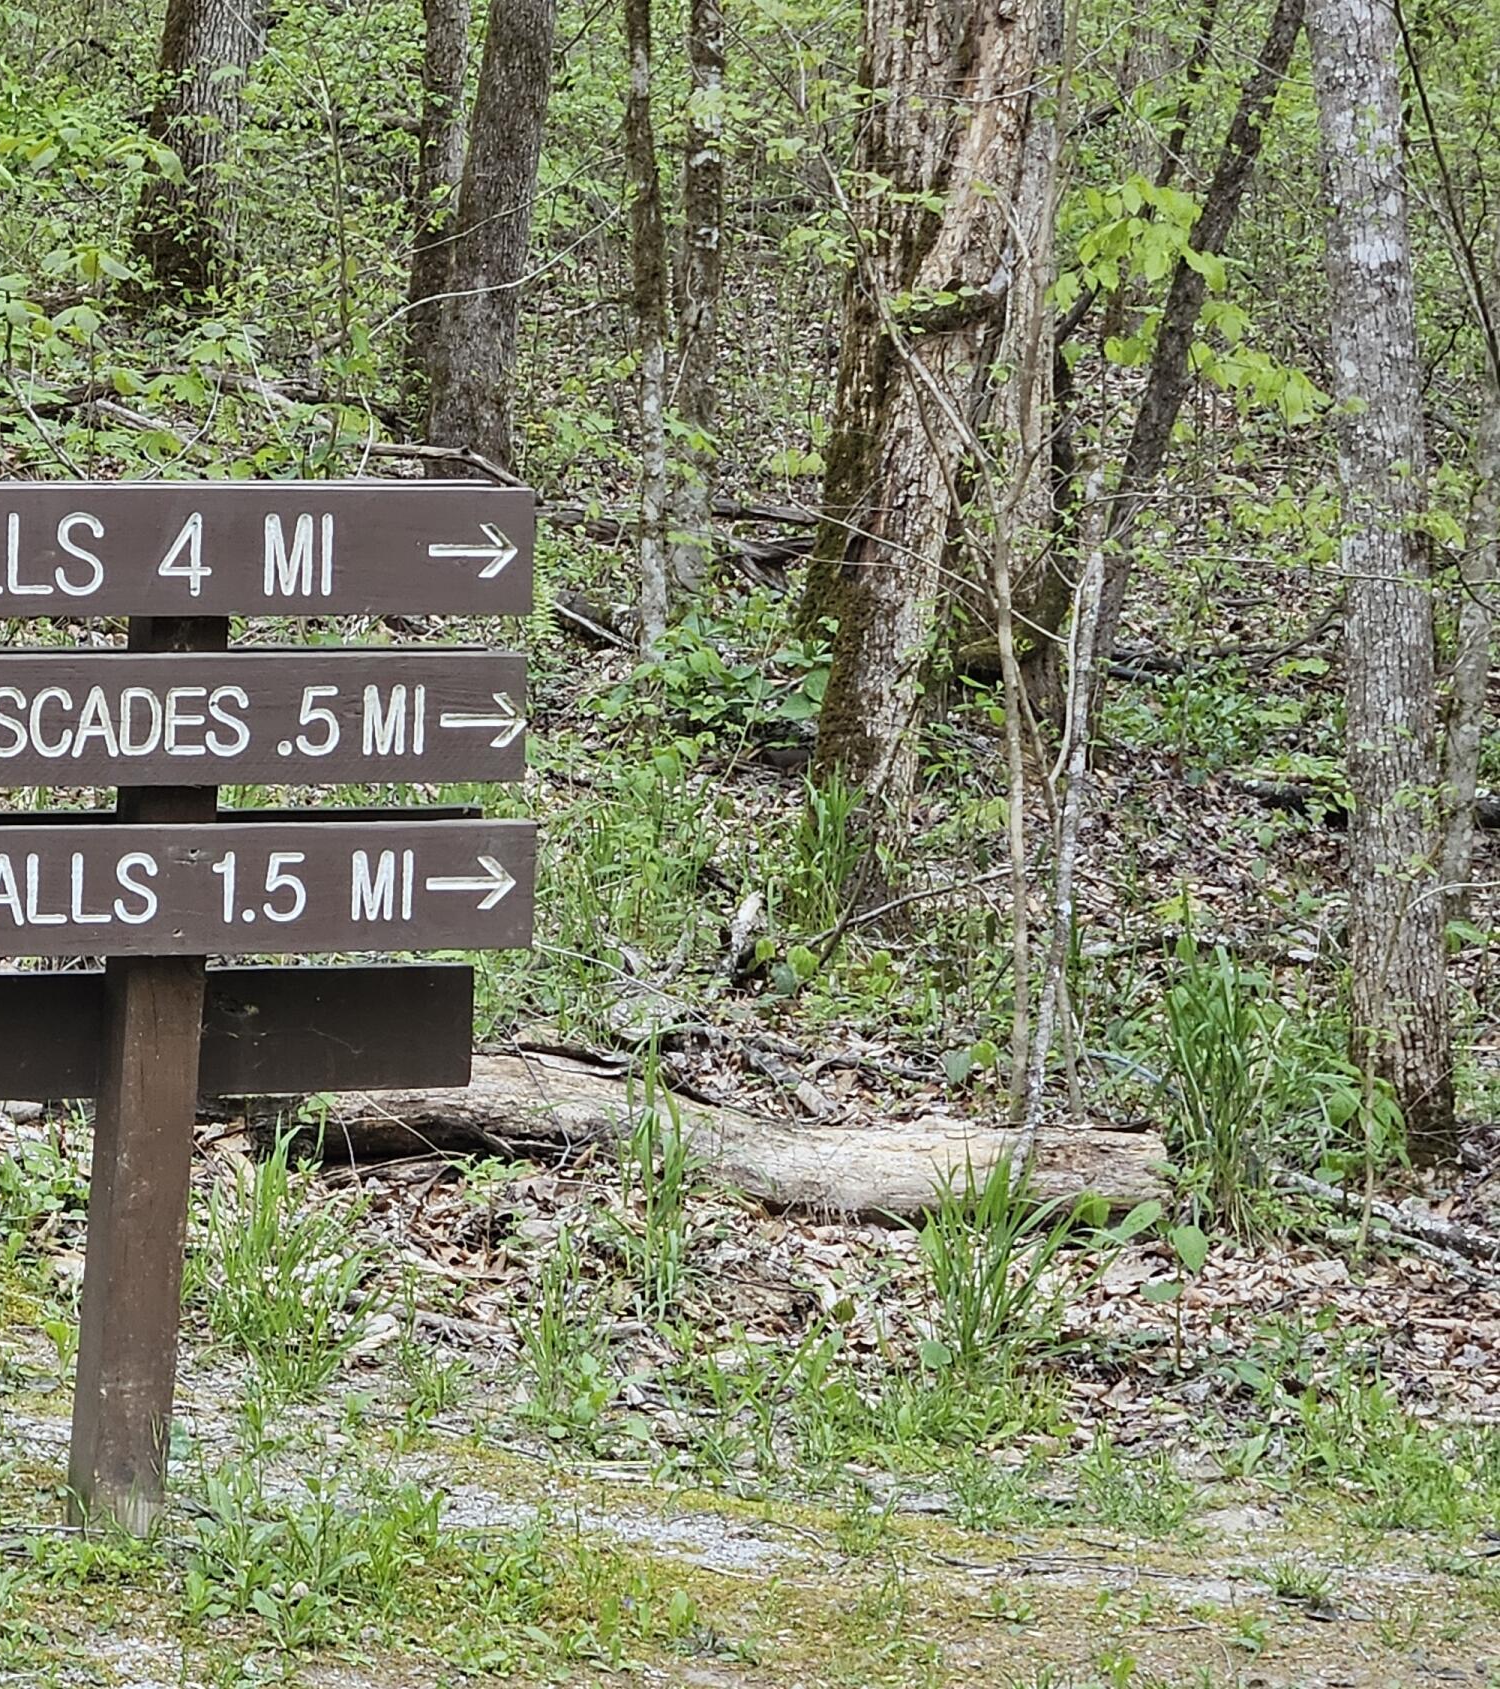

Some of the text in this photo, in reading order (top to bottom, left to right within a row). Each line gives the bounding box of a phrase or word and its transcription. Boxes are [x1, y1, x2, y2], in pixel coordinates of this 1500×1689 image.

[157, 511, 213, 598] 4
[263, 512, 334, 597] MI
[276, 685, 340, 758] .5
[362, 684, 426, 756] MI
[211, 850, 307, 924] 1.5
[350, 848, 414, 922] MI
